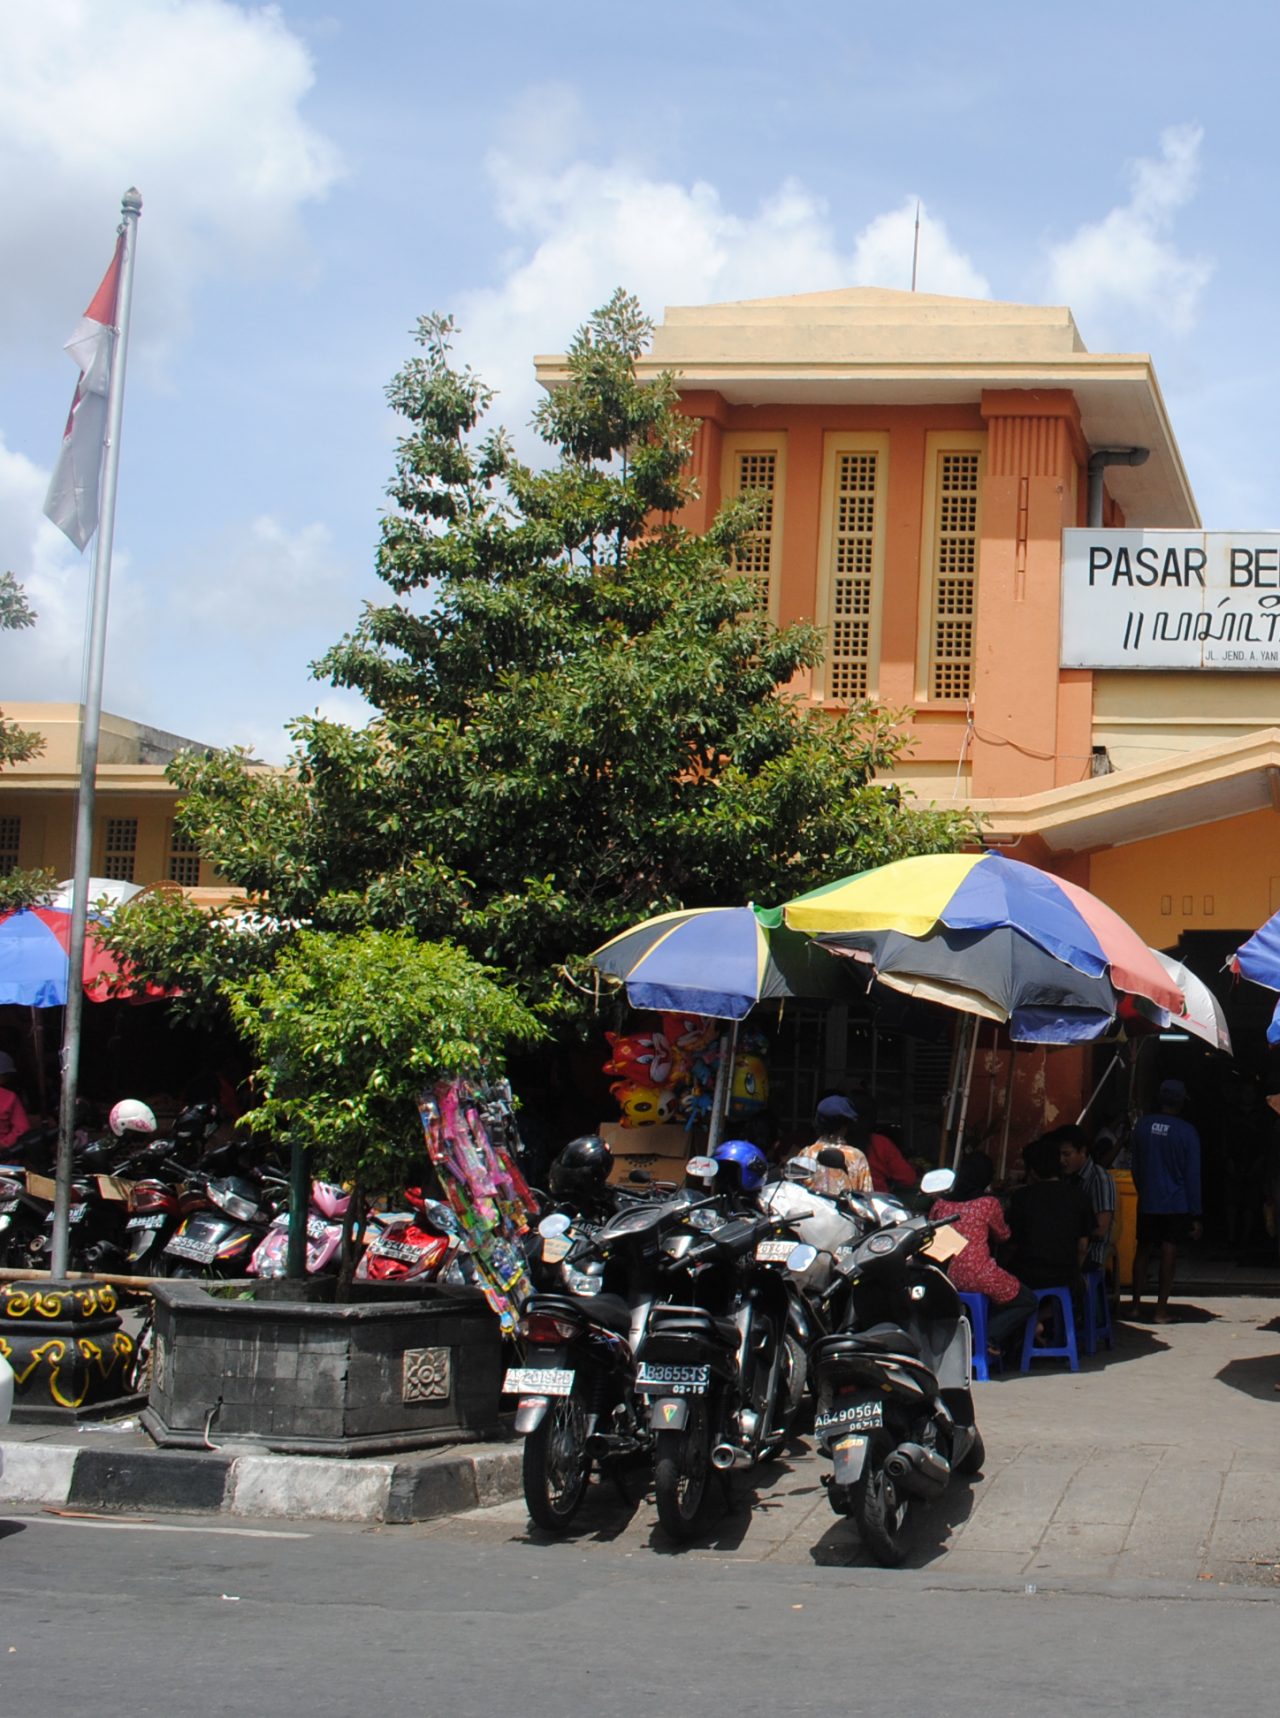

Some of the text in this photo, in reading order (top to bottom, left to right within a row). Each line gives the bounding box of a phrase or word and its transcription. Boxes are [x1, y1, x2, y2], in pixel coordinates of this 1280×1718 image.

[1089, 547, 1207, 587] PASAR
[1205, 651, 1218, 661] JL.
[1222, 651, 1247, 661] JEND.
[1249, 651, 1258, 661] A.
[1261, 651, 1279, 662] YANI
[815, 1403, 881, 1428] AB4905GA
